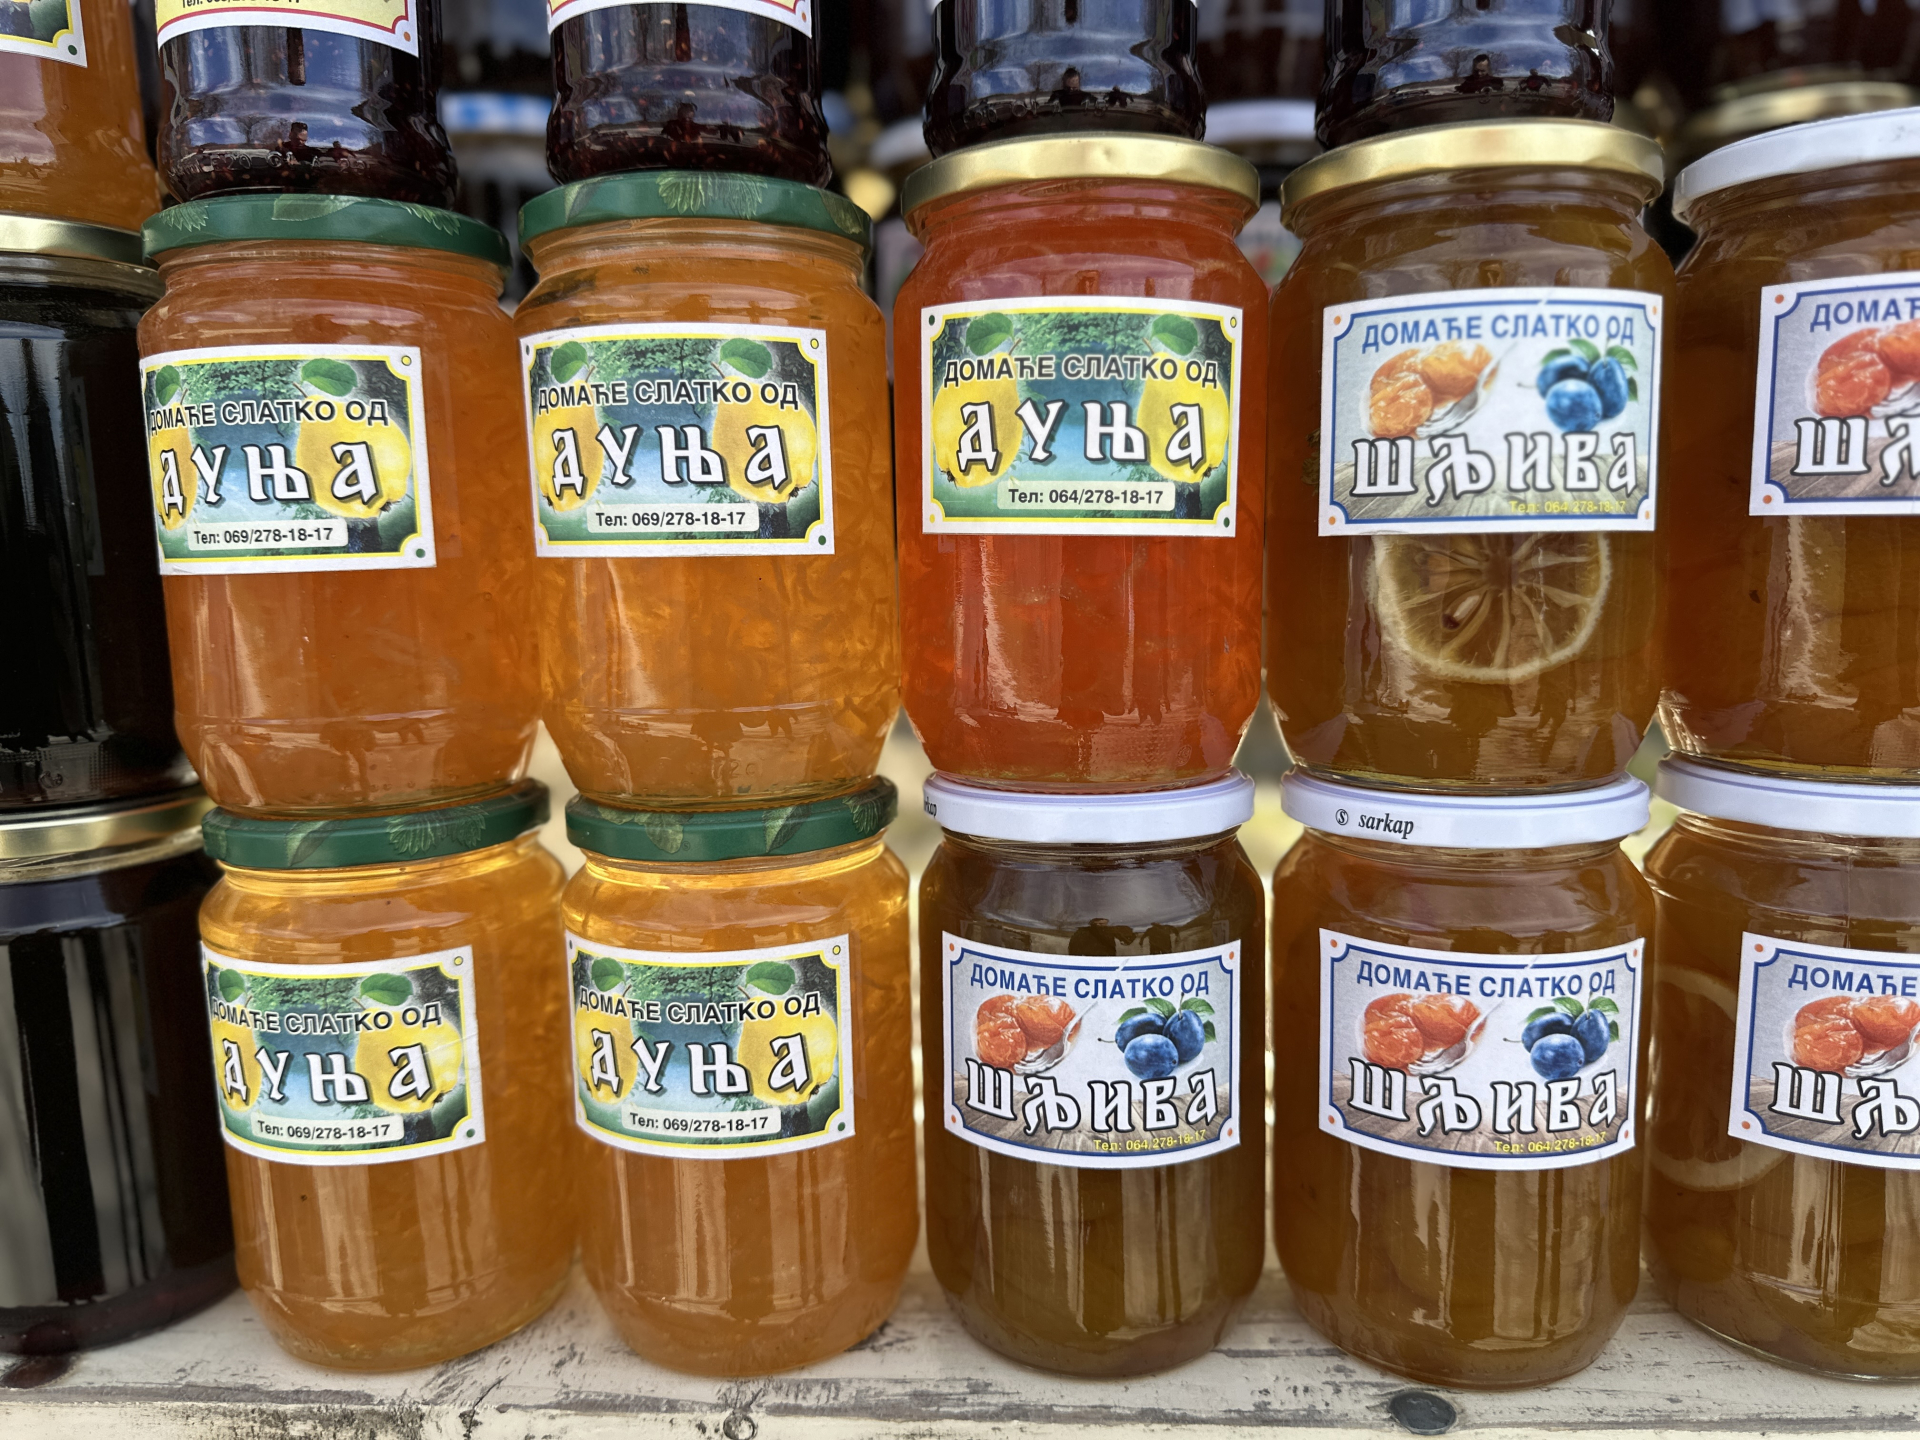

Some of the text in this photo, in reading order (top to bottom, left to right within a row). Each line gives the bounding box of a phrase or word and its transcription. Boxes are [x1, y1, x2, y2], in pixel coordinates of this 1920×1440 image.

[1362, 314, 1635, 354] ДОМАЋЕ СЛАТКО ОД
[944, 355, 1217, 389] ДОМАЋЕ СЛАТКО ОД
[538, 381, 799, 414] ДОМАЋЕ СЛАТКО ОД
[150, 400, 388, 434] ДОМАЋЕ СЛАТКО ОД
[1008, 489, 1163, 504] Тел: 064/278-18-17
[595, 511, 746, 526] Тел: 069/278-18-17
[194, 527, 333, 545] Тел: 069/278-18-17
[1358, 812, 1414, 840] sarkap
[970, 963, 1209, 998] ДОМАЋЕ СЛАТКО ОД
[1357, 960, 1615, 997] ДОМАЋЕ СЛАТКО ОД
[1788, 964, 1918, 997] ДОМАЋЕ
[213, 1003, 442, 1034] ДОМАЋЕ СЛАТКО ОД
[580, 989, 820, 1023] ДОМАЋЕ СЛАТКО ОД
[257, 1120, 391, 1139] Тел: 069/278-18-17
[630, 1112, 769, 1132] Тел: 069/278-18-17
